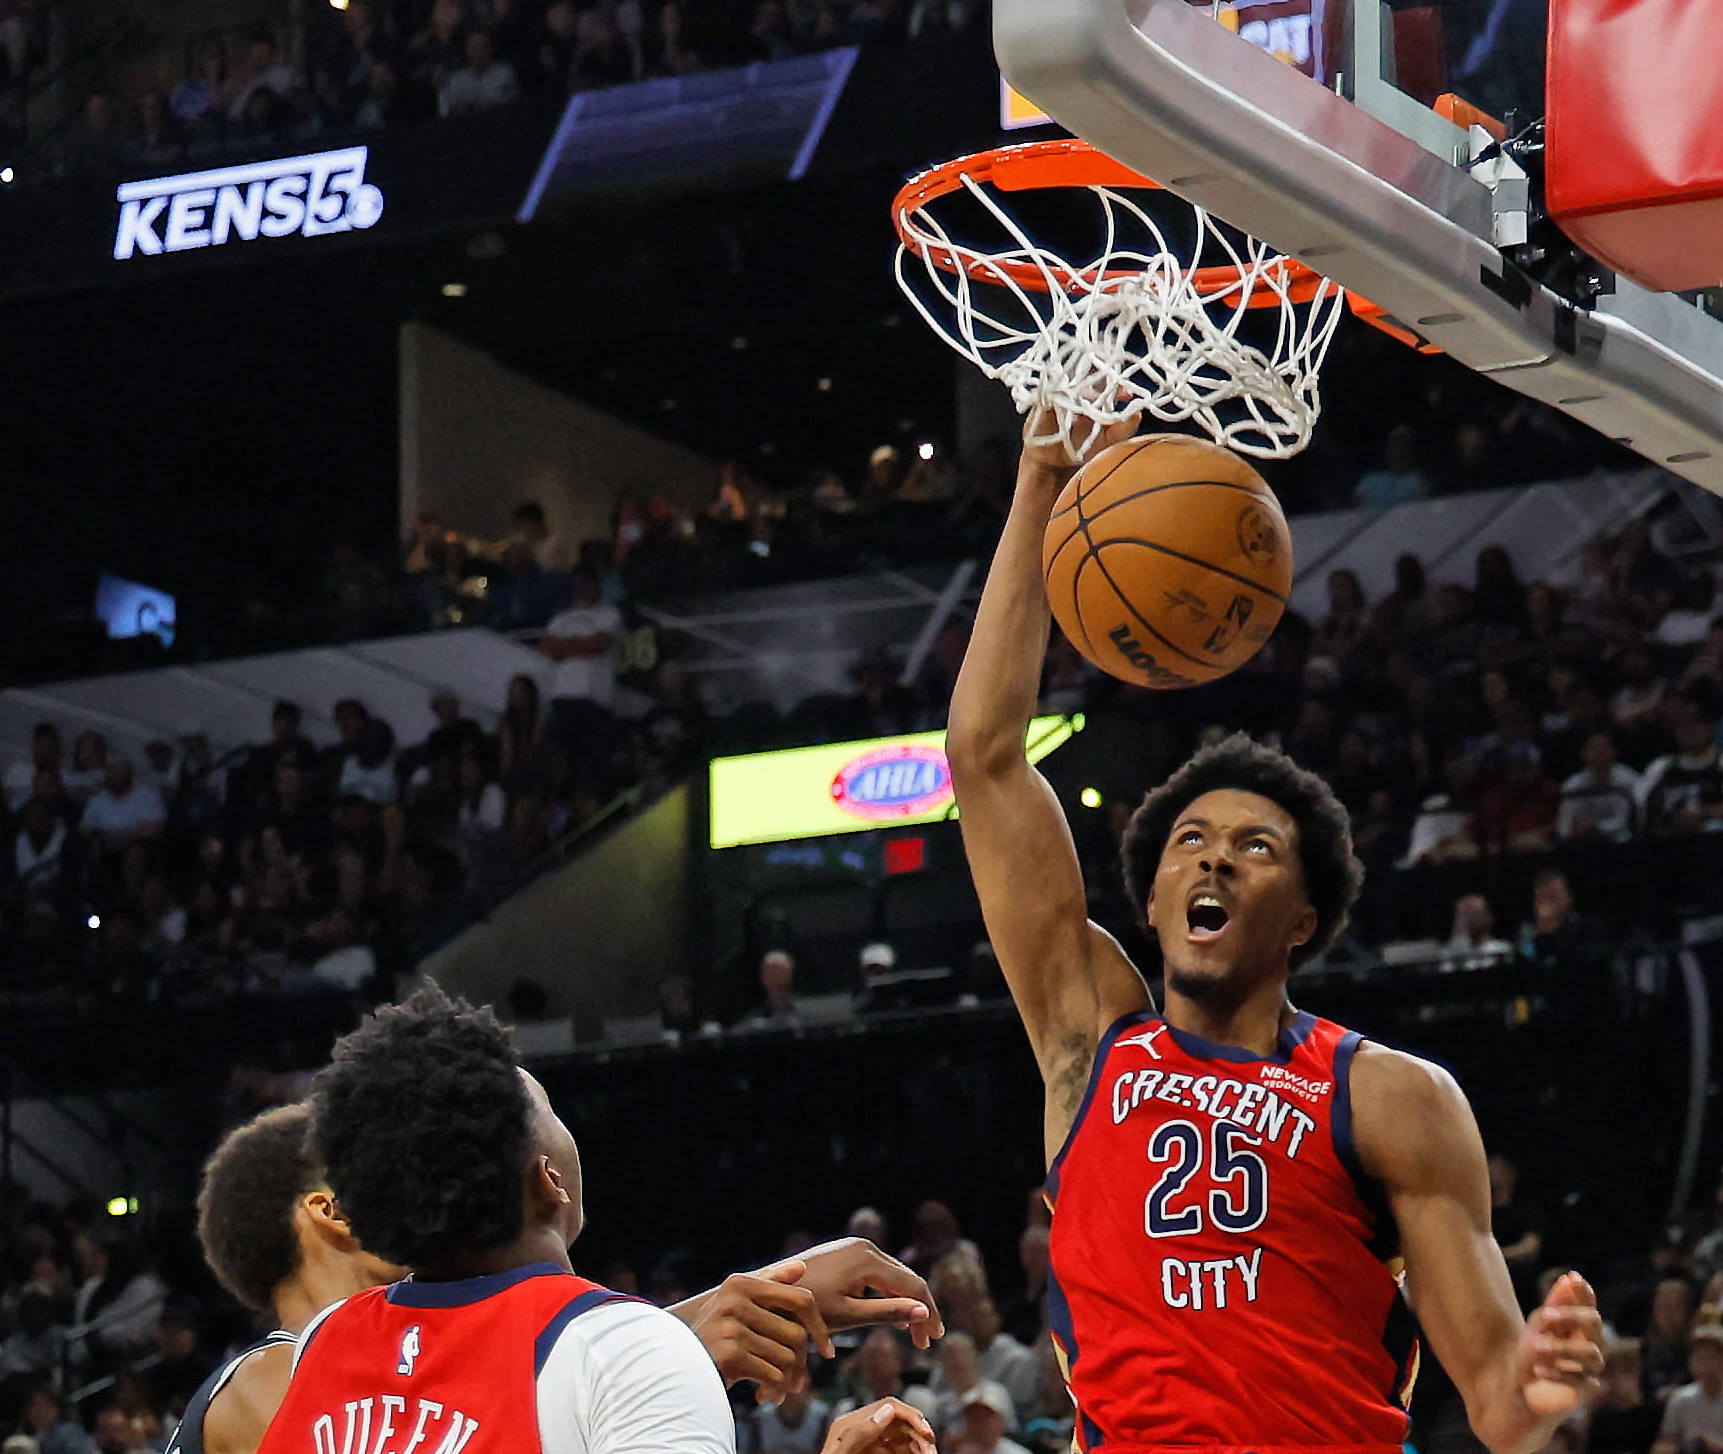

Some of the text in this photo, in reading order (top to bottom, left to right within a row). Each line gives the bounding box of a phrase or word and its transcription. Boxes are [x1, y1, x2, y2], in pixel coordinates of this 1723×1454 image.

[850, 760, 938, 802] AHIA
[1260, 1065, 1332, 1094] NEWAGE
[1111, 1069, 1316, 1159] CRESCENT
[1144, 1118, 1268, 1239] 25
[1161, 1247, 1262, 1310] CITY
